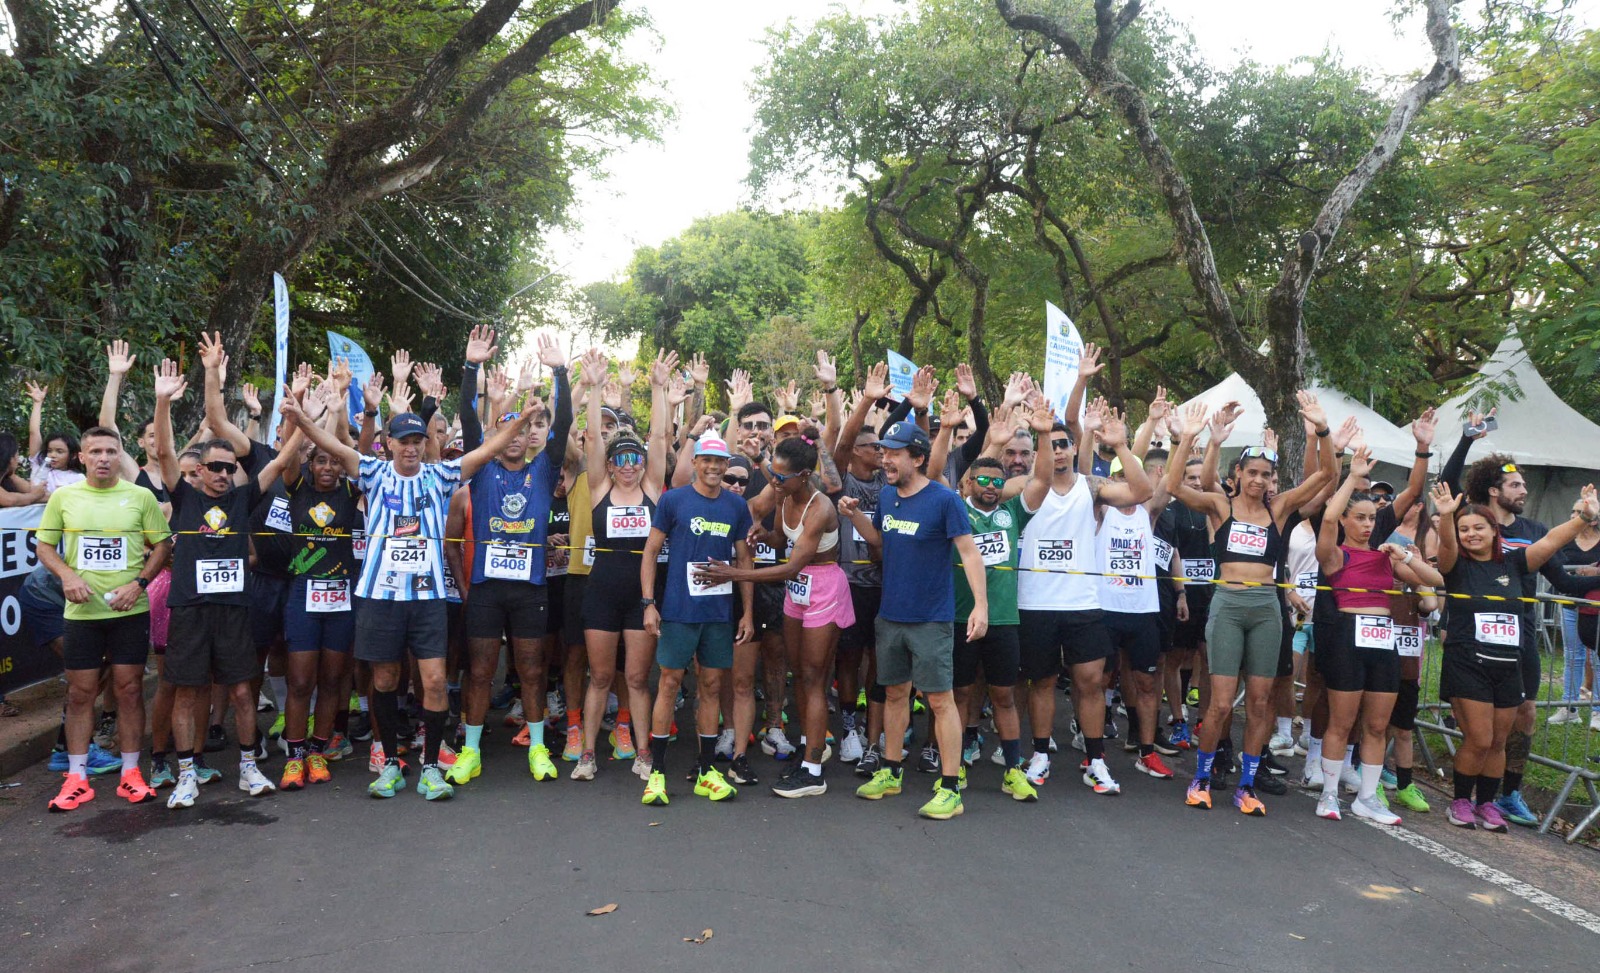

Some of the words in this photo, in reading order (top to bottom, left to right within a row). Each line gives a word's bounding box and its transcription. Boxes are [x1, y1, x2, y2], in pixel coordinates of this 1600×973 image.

[612, 516, 646, 528] 6036
[1230, 532, 1266, 548] 6029
[84, 549, 121, 560] 6168
[757, 543, 772, 555] 00
[979, 542, 1005, 556] 242
[1039, 549, 1072, 561] 6290
[1155, 547, 1169, 562] 198
[391, 550, 426, 562] 6241
[491, 557, 526, 571] 6408
[1110, 559, 1141, 570] 6331
[202, 571, 238, 583] 6191
[1186, 568, 1213, 577] 6340
[312, 591, 346, 603] 6154
[1361, 627, 1391, 639] 6087
[1481, 623, 1516, 636] 6116
[1396, 636, 1419, 648] 193
